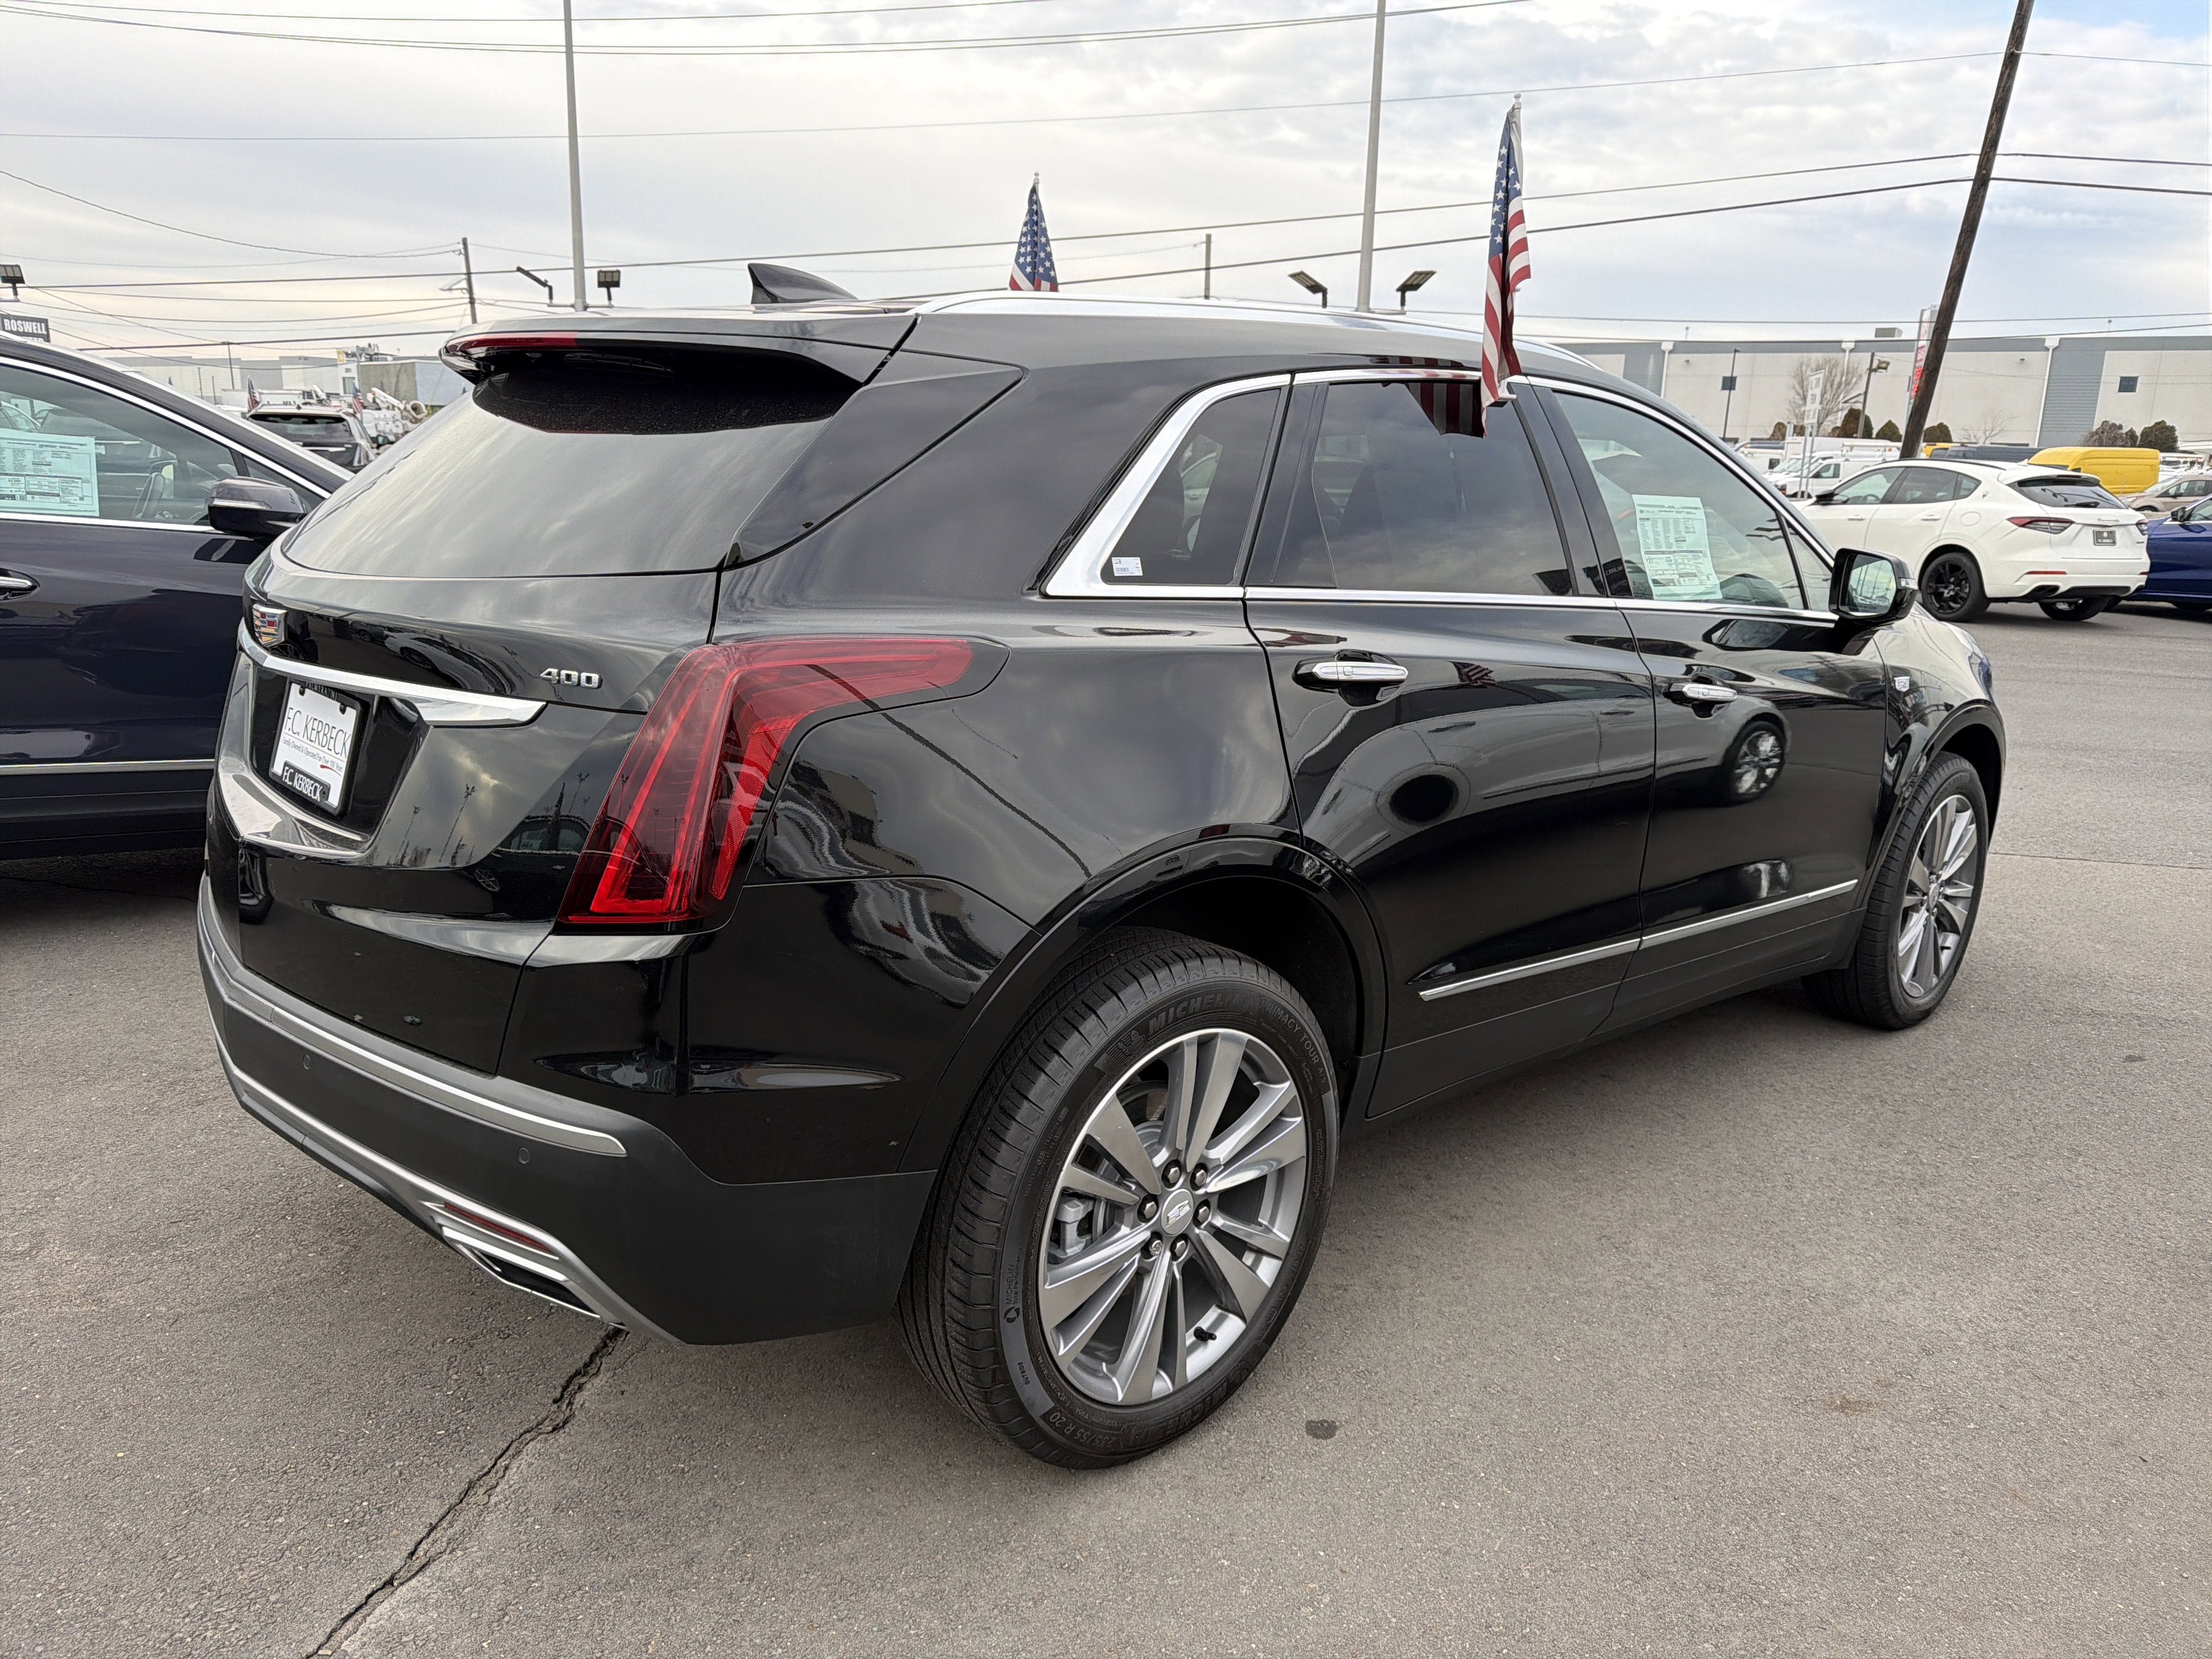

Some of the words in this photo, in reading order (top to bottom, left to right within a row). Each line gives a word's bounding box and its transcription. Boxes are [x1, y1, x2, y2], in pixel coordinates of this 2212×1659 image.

[3, 319, 47, 335] ROSWELL
[540, 668, 599, 688] 400
[284, 707, 301, 736] F.C.
[302, 715, 352, 758] KERBECK
[293, 772, 323, 802] KERBECK
[1148, 992, 1245, 1036] MICHELIN
[1259, 998, 1301, 1034] PRIMACY
[1300, 1033, 1319, 1065] TOUR
[1318, 1067, 1327, 1084] A/S
[1006, 1264, 1014, 1305] MICHELIN
[1018, 1362, 1030, 1385] OUTSIDE
[1049, 1412, 1067, 1427] 20
[1064, 1424, 1076, 1435] R
[1073, 1429, 1117, 1448] 235/55
